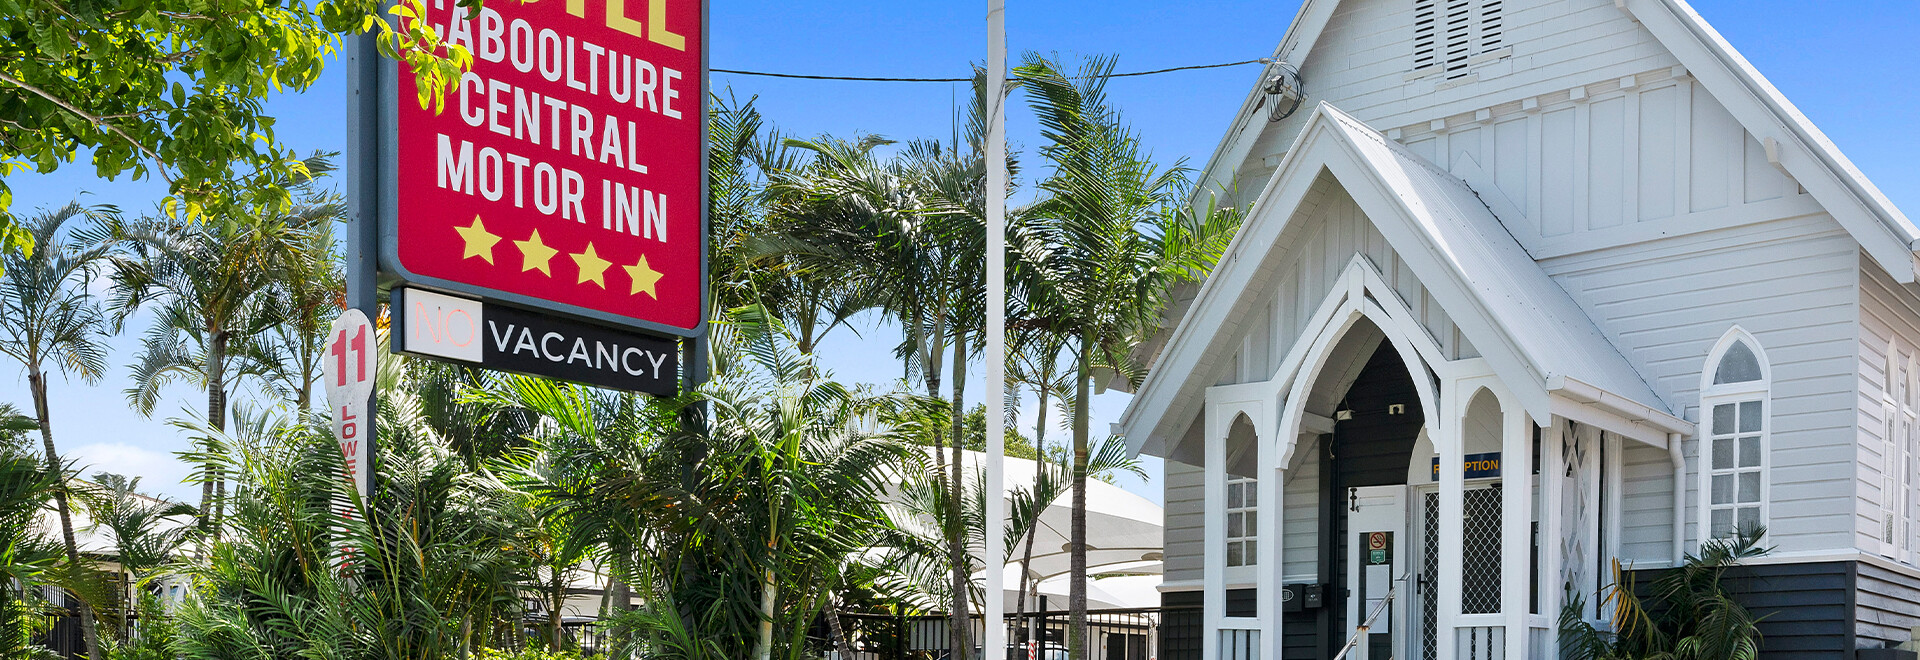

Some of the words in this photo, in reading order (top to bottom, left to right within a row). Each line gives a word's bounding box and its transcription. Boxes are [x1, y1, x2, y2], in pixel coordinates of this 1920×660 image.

[459, 71, 648, 174] CENTRAL
[437, 132, 587, 224] MOTOR
[602, 178, 667, 243] INN
[331, 324, 366, 387] 11
[415, 302, 475, 347] NO
[488, 319, 667, 380] VACANCY
[1433, 459, 1499, 475] RPTION
